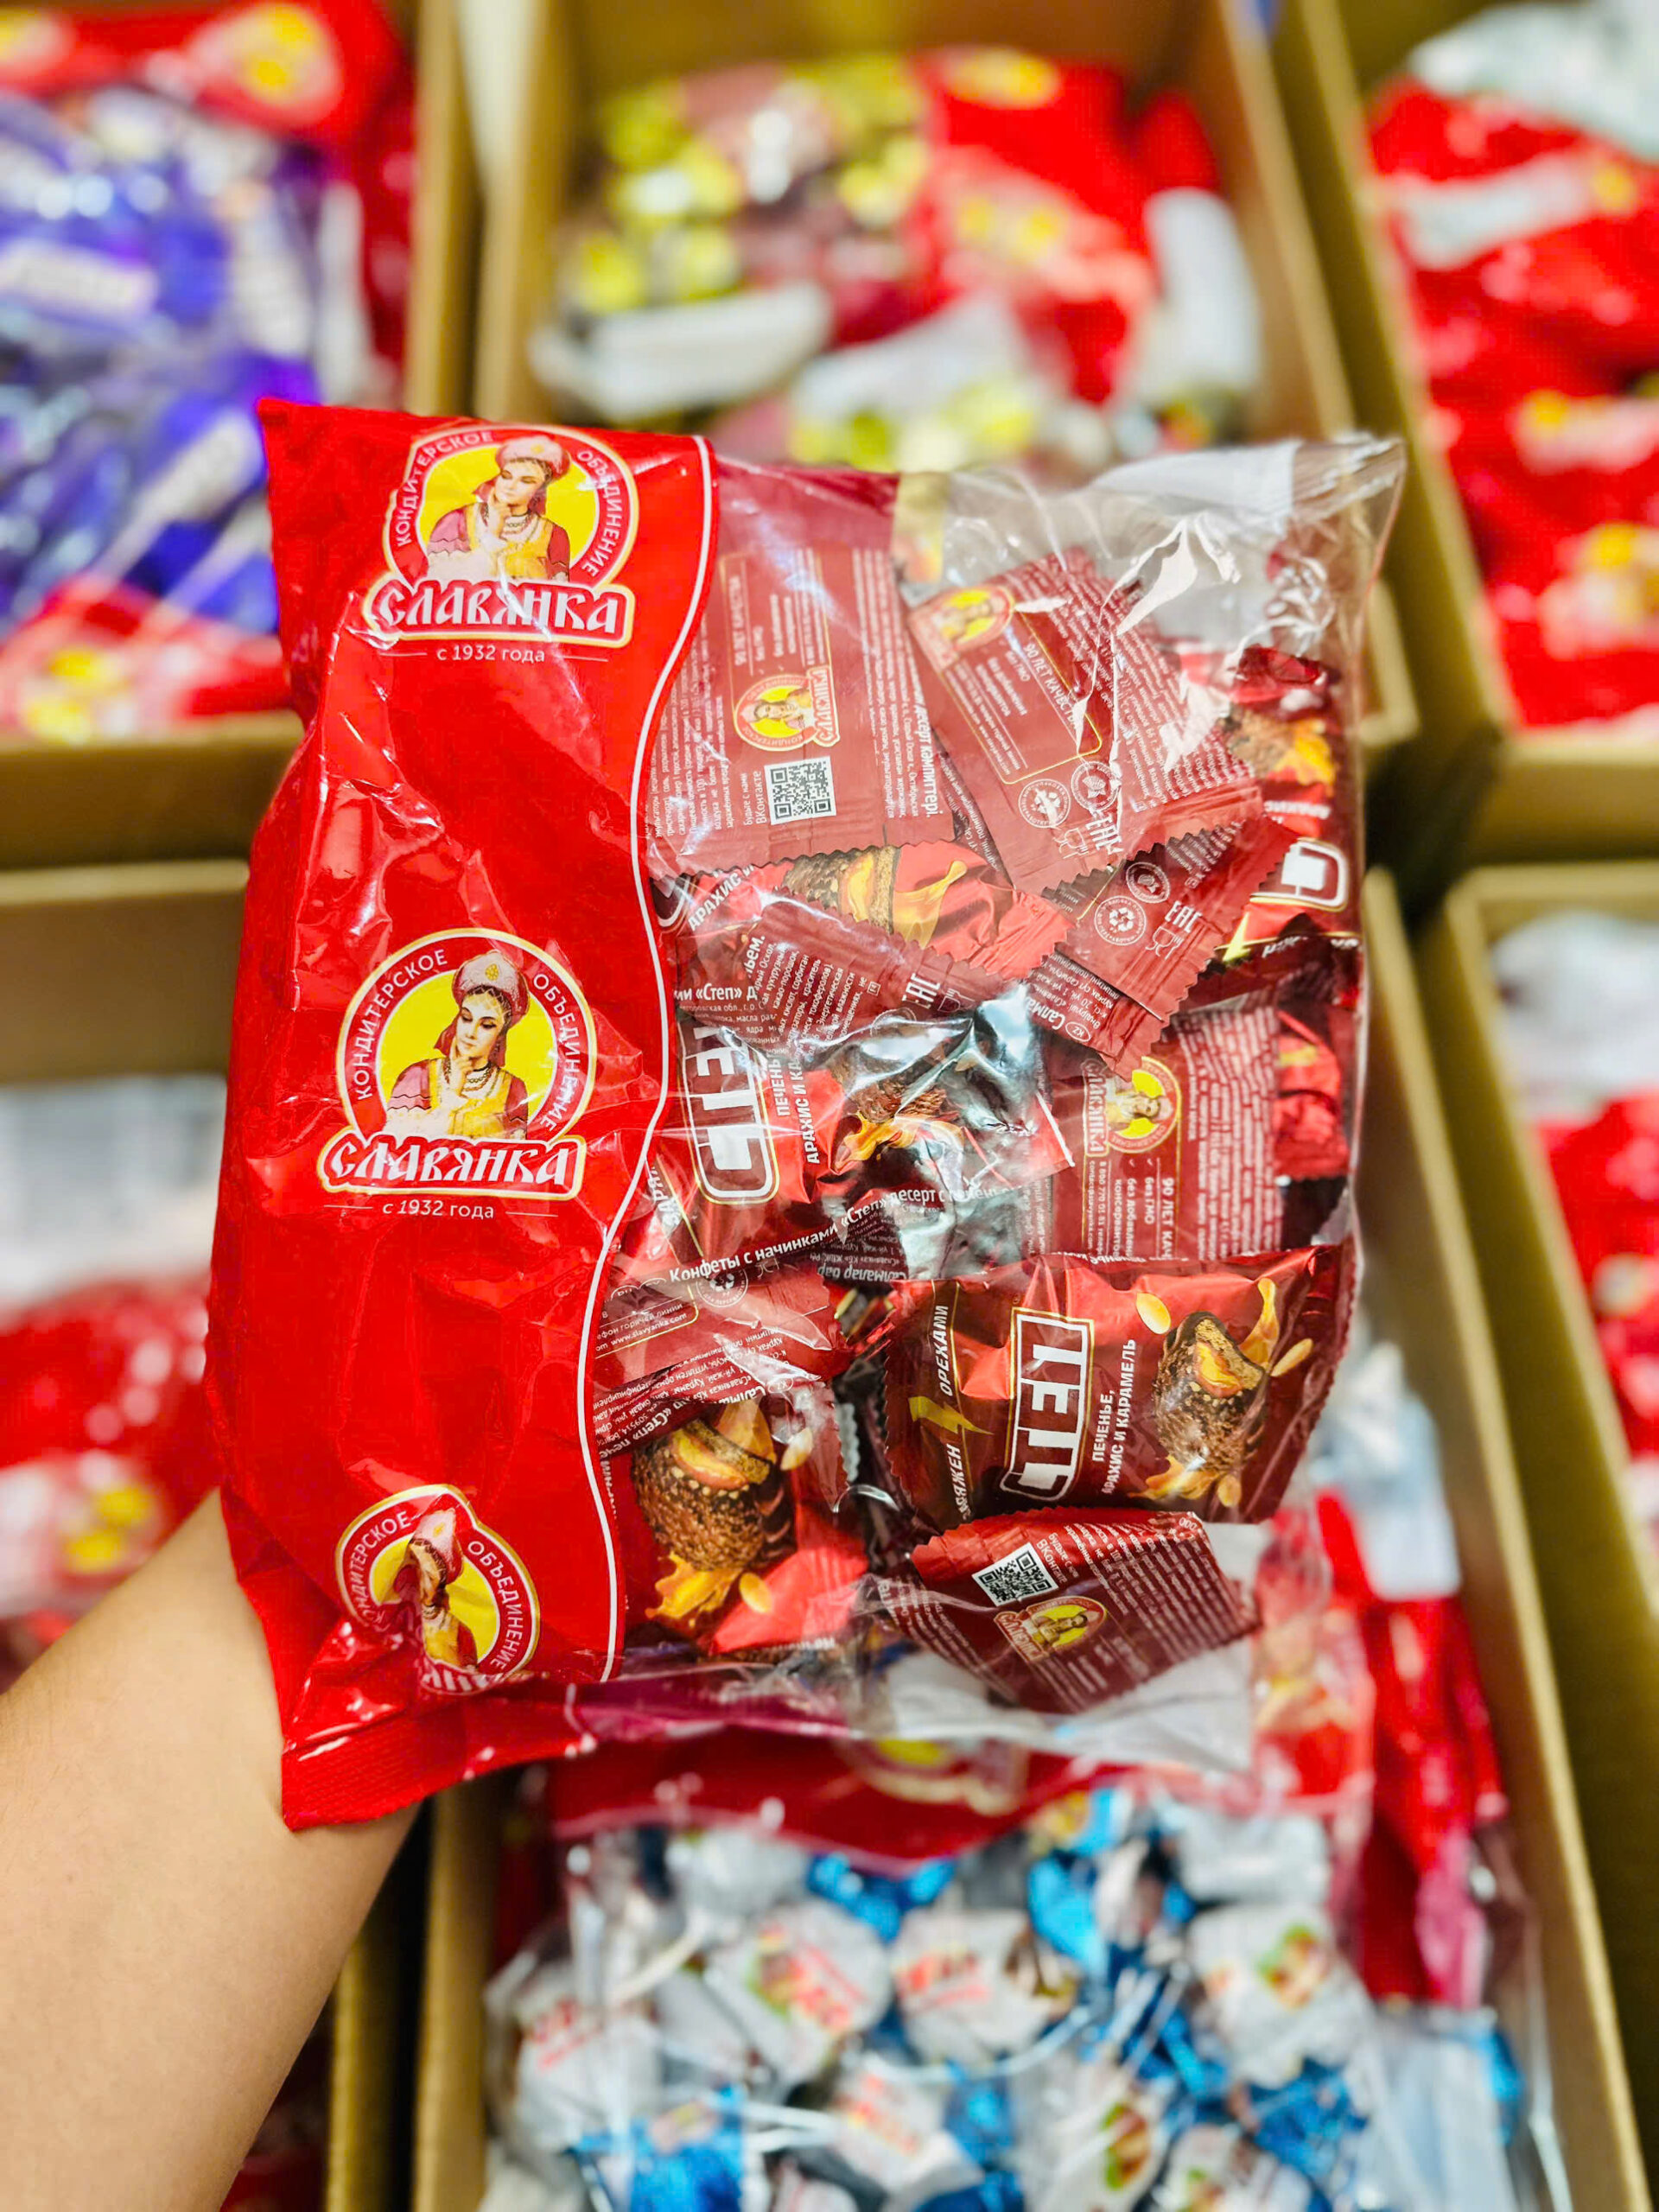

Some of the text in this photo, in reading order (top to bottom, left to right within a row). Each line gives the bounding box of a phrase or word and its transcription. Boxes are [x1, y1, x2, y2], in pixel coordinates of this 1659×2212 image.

[396, 431, 493, 547] КОНДИТЕРСКОЕ
[577, 450, 622, 577] ОБЪЕДИНЕНИЕ
[378, 586, 620, 635] СЛАВЯНКА
[437, 645, 545, 665] с 1932 года
[1021, 640, 1040, 659] 90
[1030, 654, 1053, 680] ЛЕТ
[912, 702, 932, 745] десерт
[751, 770, 766, 823] ВКонтакте
[683, 870, 745, 931] АРАХИС
[1163, 898, 1203, 935] EAC
[696, 982, 742, 1001] «Степ»
[791, 953, 810, 990] сорбитан
[834, 970, 855, 1013] влажности
[857, 976, 868, 988] не
[352, 949, 448, 1100] КОНДИТЕРСКОЕ
[1080, 997, 1092, 1009] 20
[533, 973, 581, 1131] ОБЪЕДИНЕНИЕ
[1071, 1025, 1085, 1038] KZ
[792, 1083, 820, 1164] АРАХИС И
[329, 1141, 569, 1185] СЛАВЯНКА
[383, 1199, 494, 1219] с 1932 года
[1126, 1178, 1136, 1197] без
[1143, 1177, 1154, 1224] без ГМО
[668, 1254, 741, 1285] Конфеты
[741, 1249, 753, 1264] с
[754, 1224, 839, 1260] начинками
[841, 1198, 887, 1227] «Степ»
[1161, 1177, 1173, 1258] 90 ЛЕТ КАЧ
[611, 1314, 687, 1345] www.slavyanka.com
[1111, 1338, 1140, 1427] КАРАМЕЛЬ
[934, 1305, 973, 1521] АРЯЖЕН ОРЕХАМИ
[999, 1313, 1089, 1502] СТЕП
[1090, 1389, 1116, 1462] ПЕЧЕНЬЕ,
[599, 1408, 672, 1459] «Степ» пече
[1113, 1429, 1125, 1440] И
[1035, 1537, 1068, 1586] ВКонтакте
[467, 1541, 524, 1671] ОБЪЕДИНЕНИЕ
